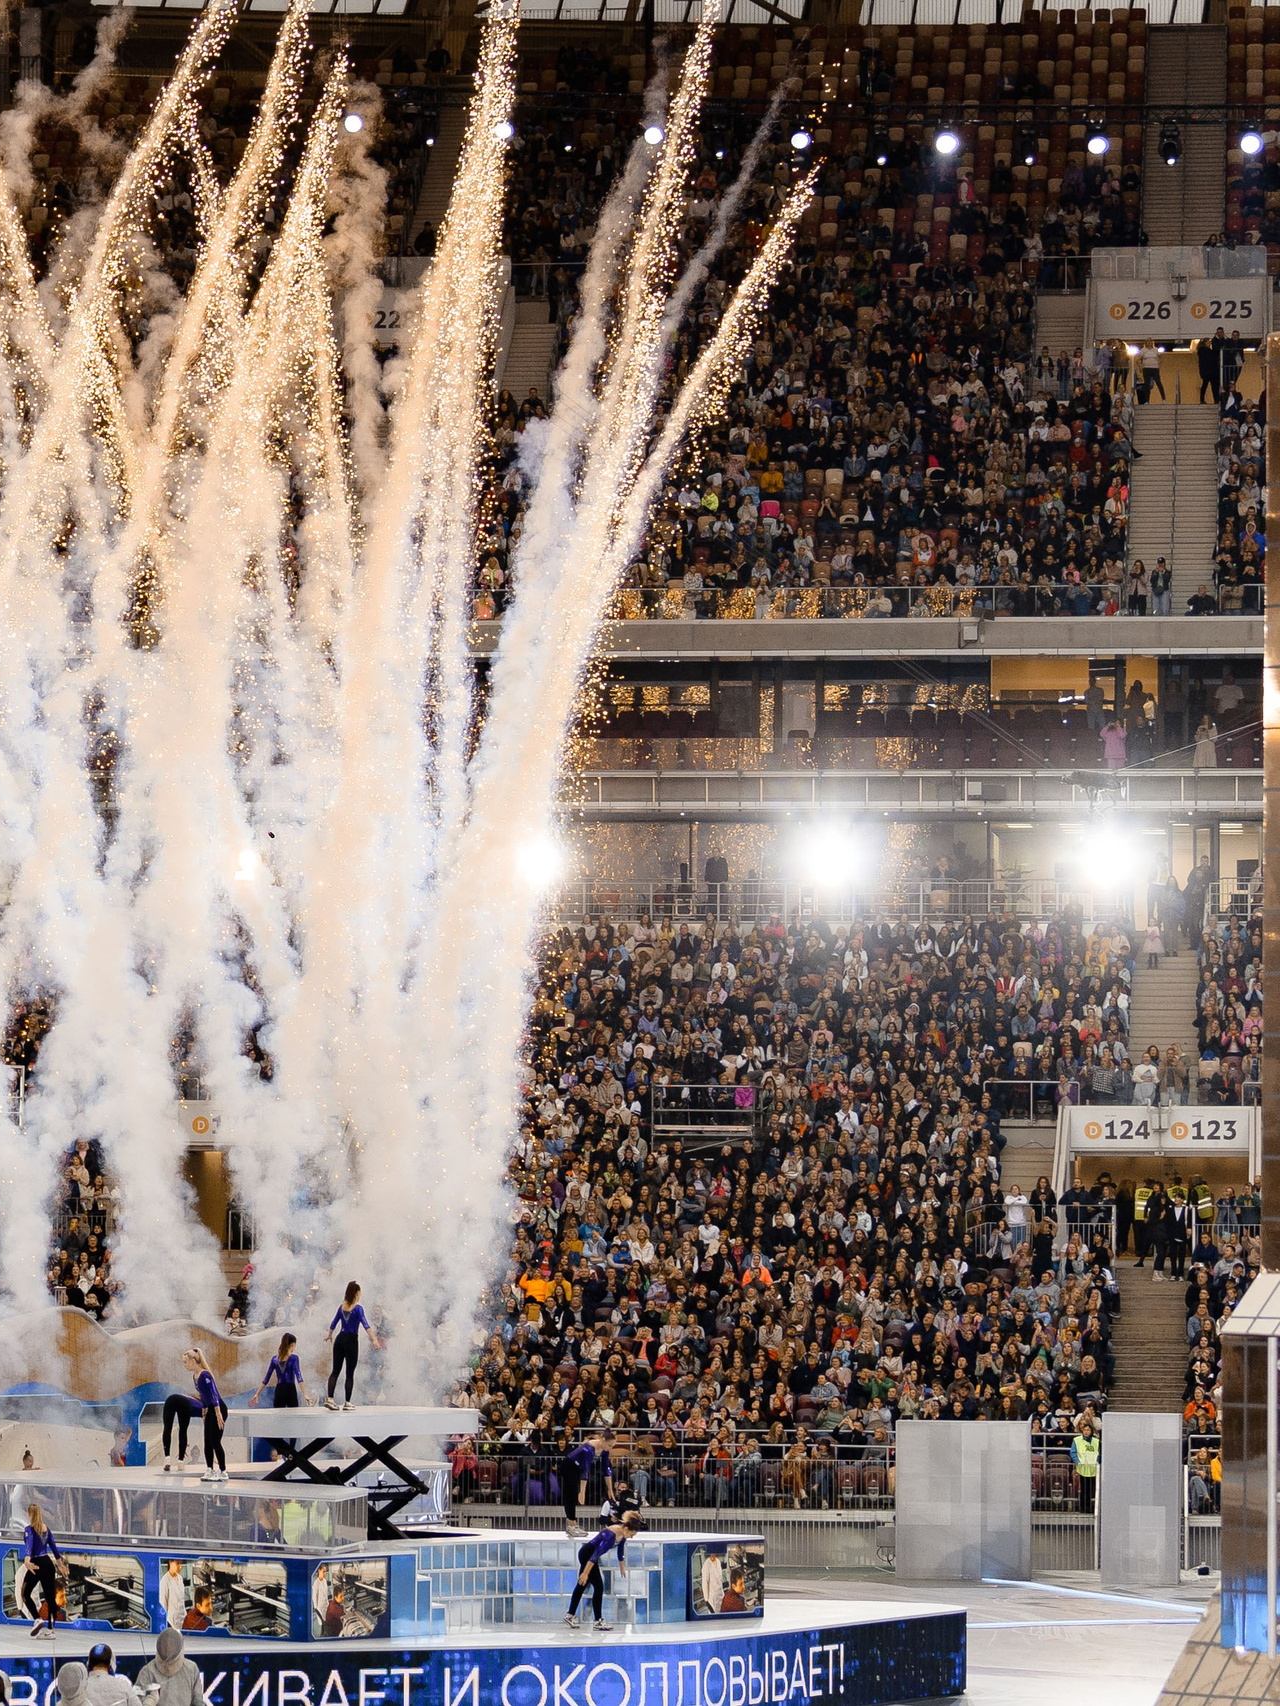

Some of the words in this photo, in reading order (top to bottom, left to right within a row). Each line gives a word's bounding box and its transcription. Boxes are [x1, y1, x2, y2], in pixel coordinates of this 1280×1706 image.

[1128, 301, 1171, 320] 226
[1209, 300, 1252, 319] 225
[1105, 1119, 1150, 1140] 124
[1192, 1119, 1237, 1140] 123
[444, 1667, 479, 1706] И
